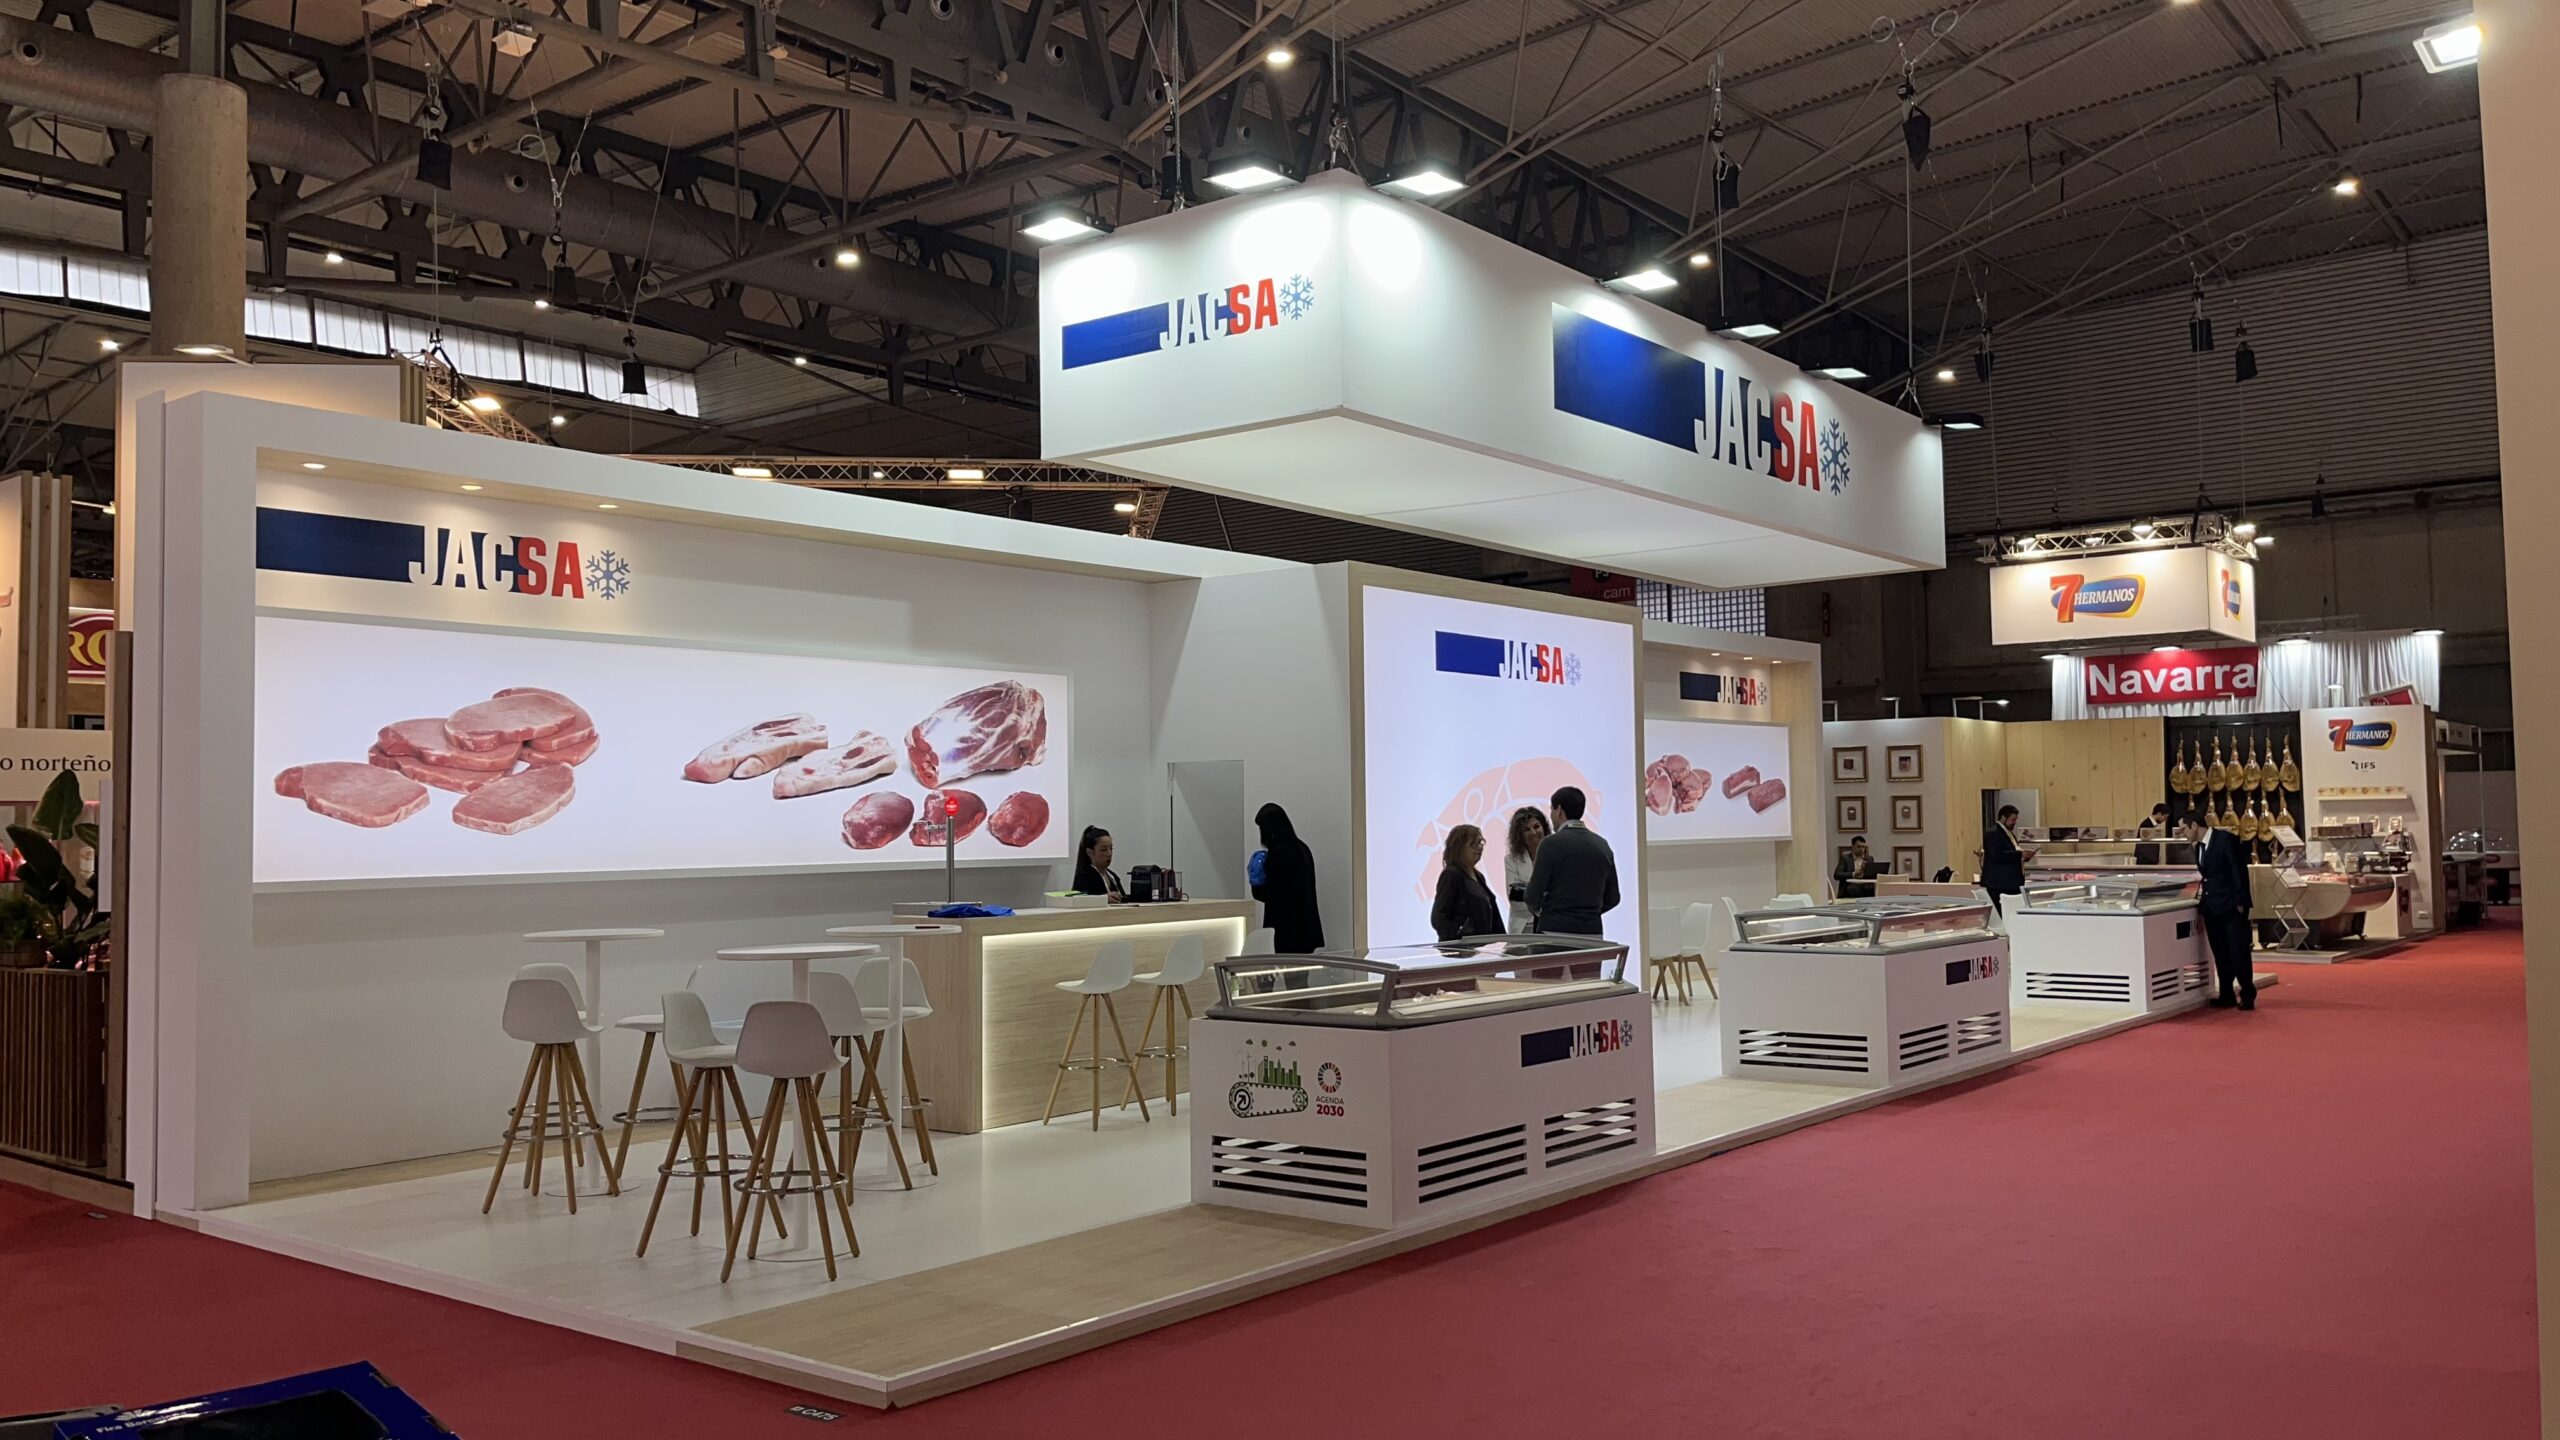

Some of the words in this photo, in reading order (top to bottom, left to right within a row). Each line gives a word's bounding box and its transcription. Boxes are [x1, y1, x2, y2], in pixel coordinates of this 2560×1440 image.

[1159, 278, 1279, 350] JACSA
[1694, 363, 1821, 491] JACSA
[408, 525, 585, 599] JACSA
[2050, 574, 2084, 623] 7
[2073, 587, 2135, 606] HERMANOS
[1499, 640, 1565, 685] JACSA
[2088, 662, 2256, 697] Navarra
[1717, 675, 1757, 706] JACSA
[2328, 719, 2354, 752] 7
[2345, 729, 2390, 741] HERMANOS
[21, 754, 111, 772] norteño
[1569, 1019, 1620, 1059] JACSA
[1315, 1095, 1344, 1105] AGENDA
[1316, 1103, 1344, 1117] 2030
